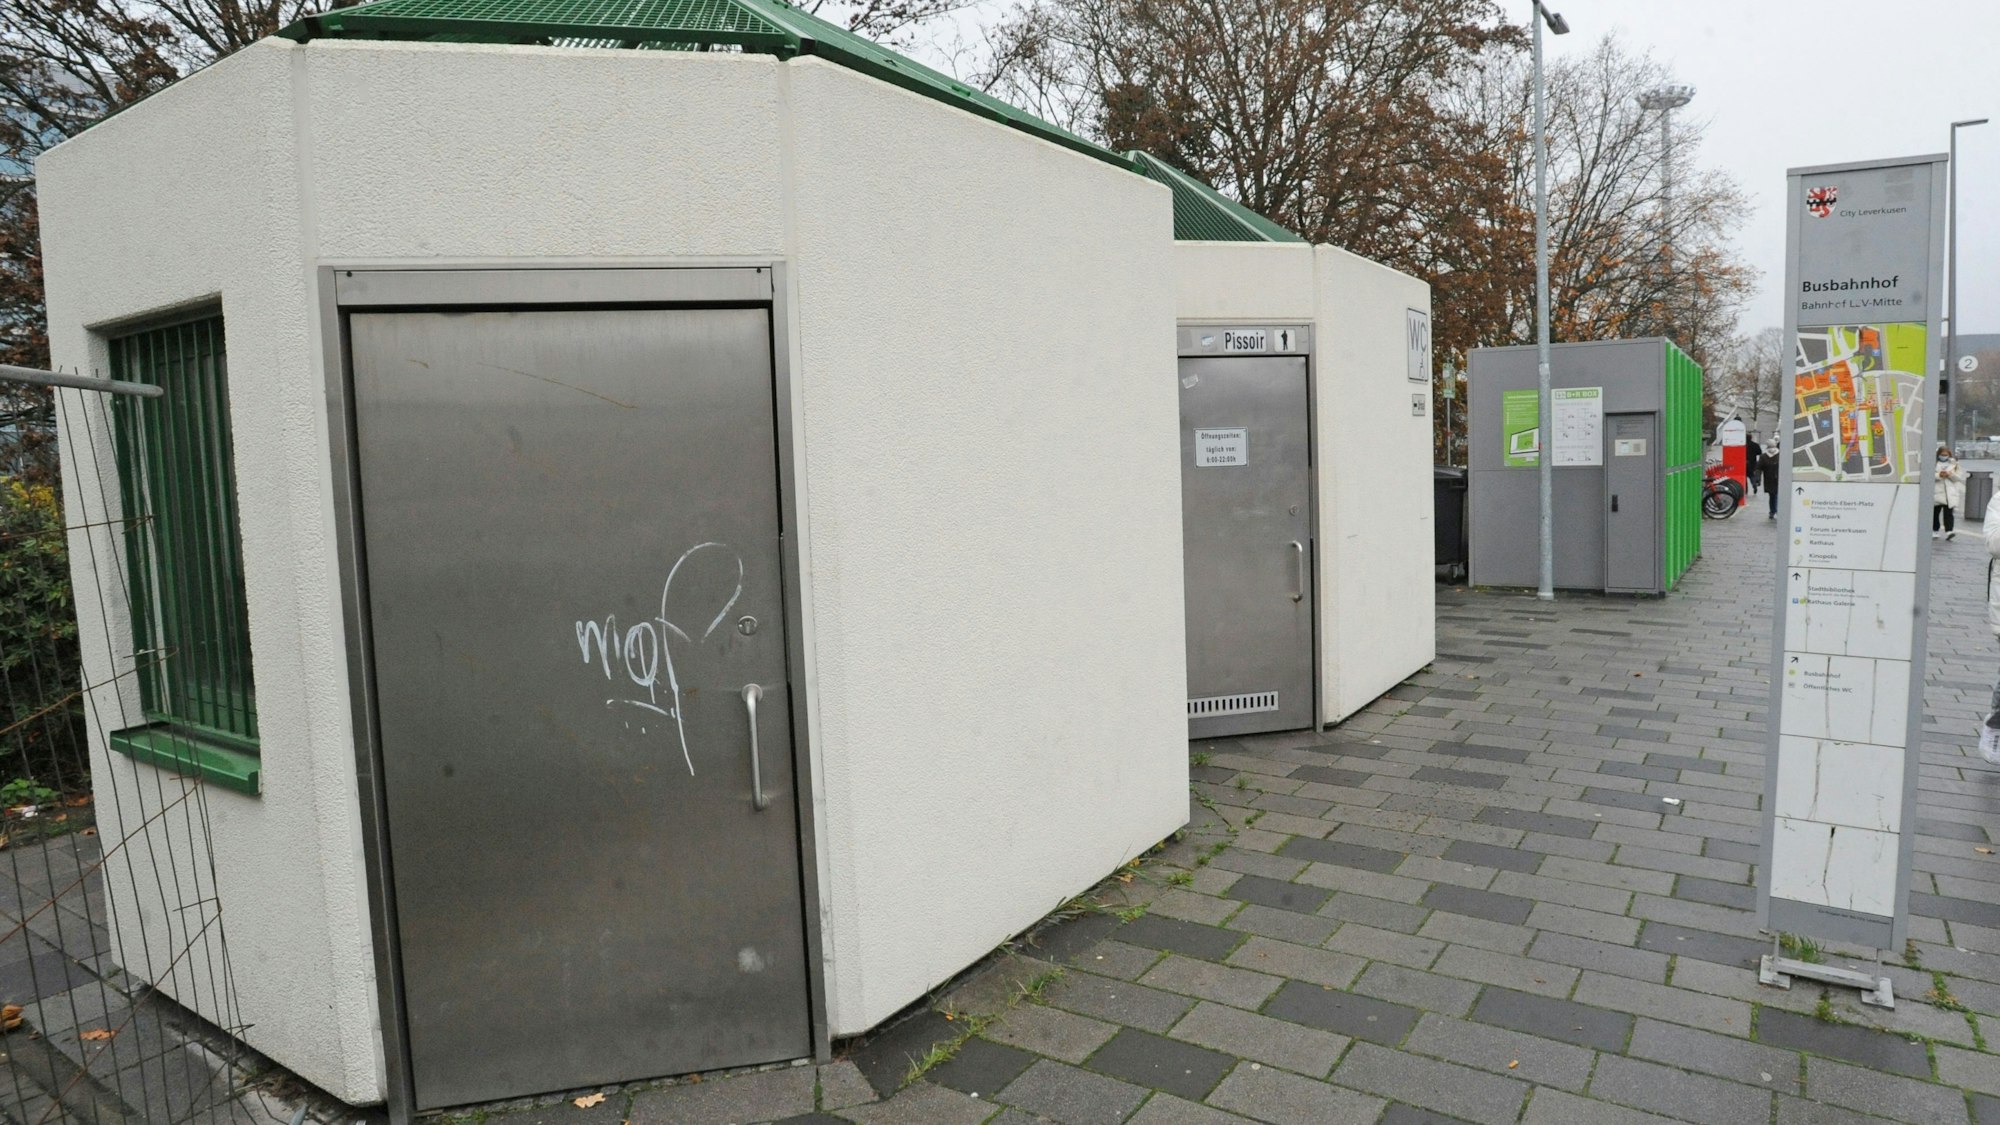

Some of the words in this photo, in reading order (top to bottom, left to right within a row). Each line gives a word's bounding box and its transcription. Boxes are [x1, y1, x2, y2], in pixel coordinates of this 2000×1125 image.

[1839, 210, 1856, 218] City
[1858, 207, 1907, 216] Leverkusen
[1802, 275, 1899, 293] Busbahnhof
[1224, 332, 1265, 350] Pissoir
[1409, 318, 1427, 352] WC
[1964, 358, 1973, 369] 2
[1582, 389, 1598, 397] BOX
